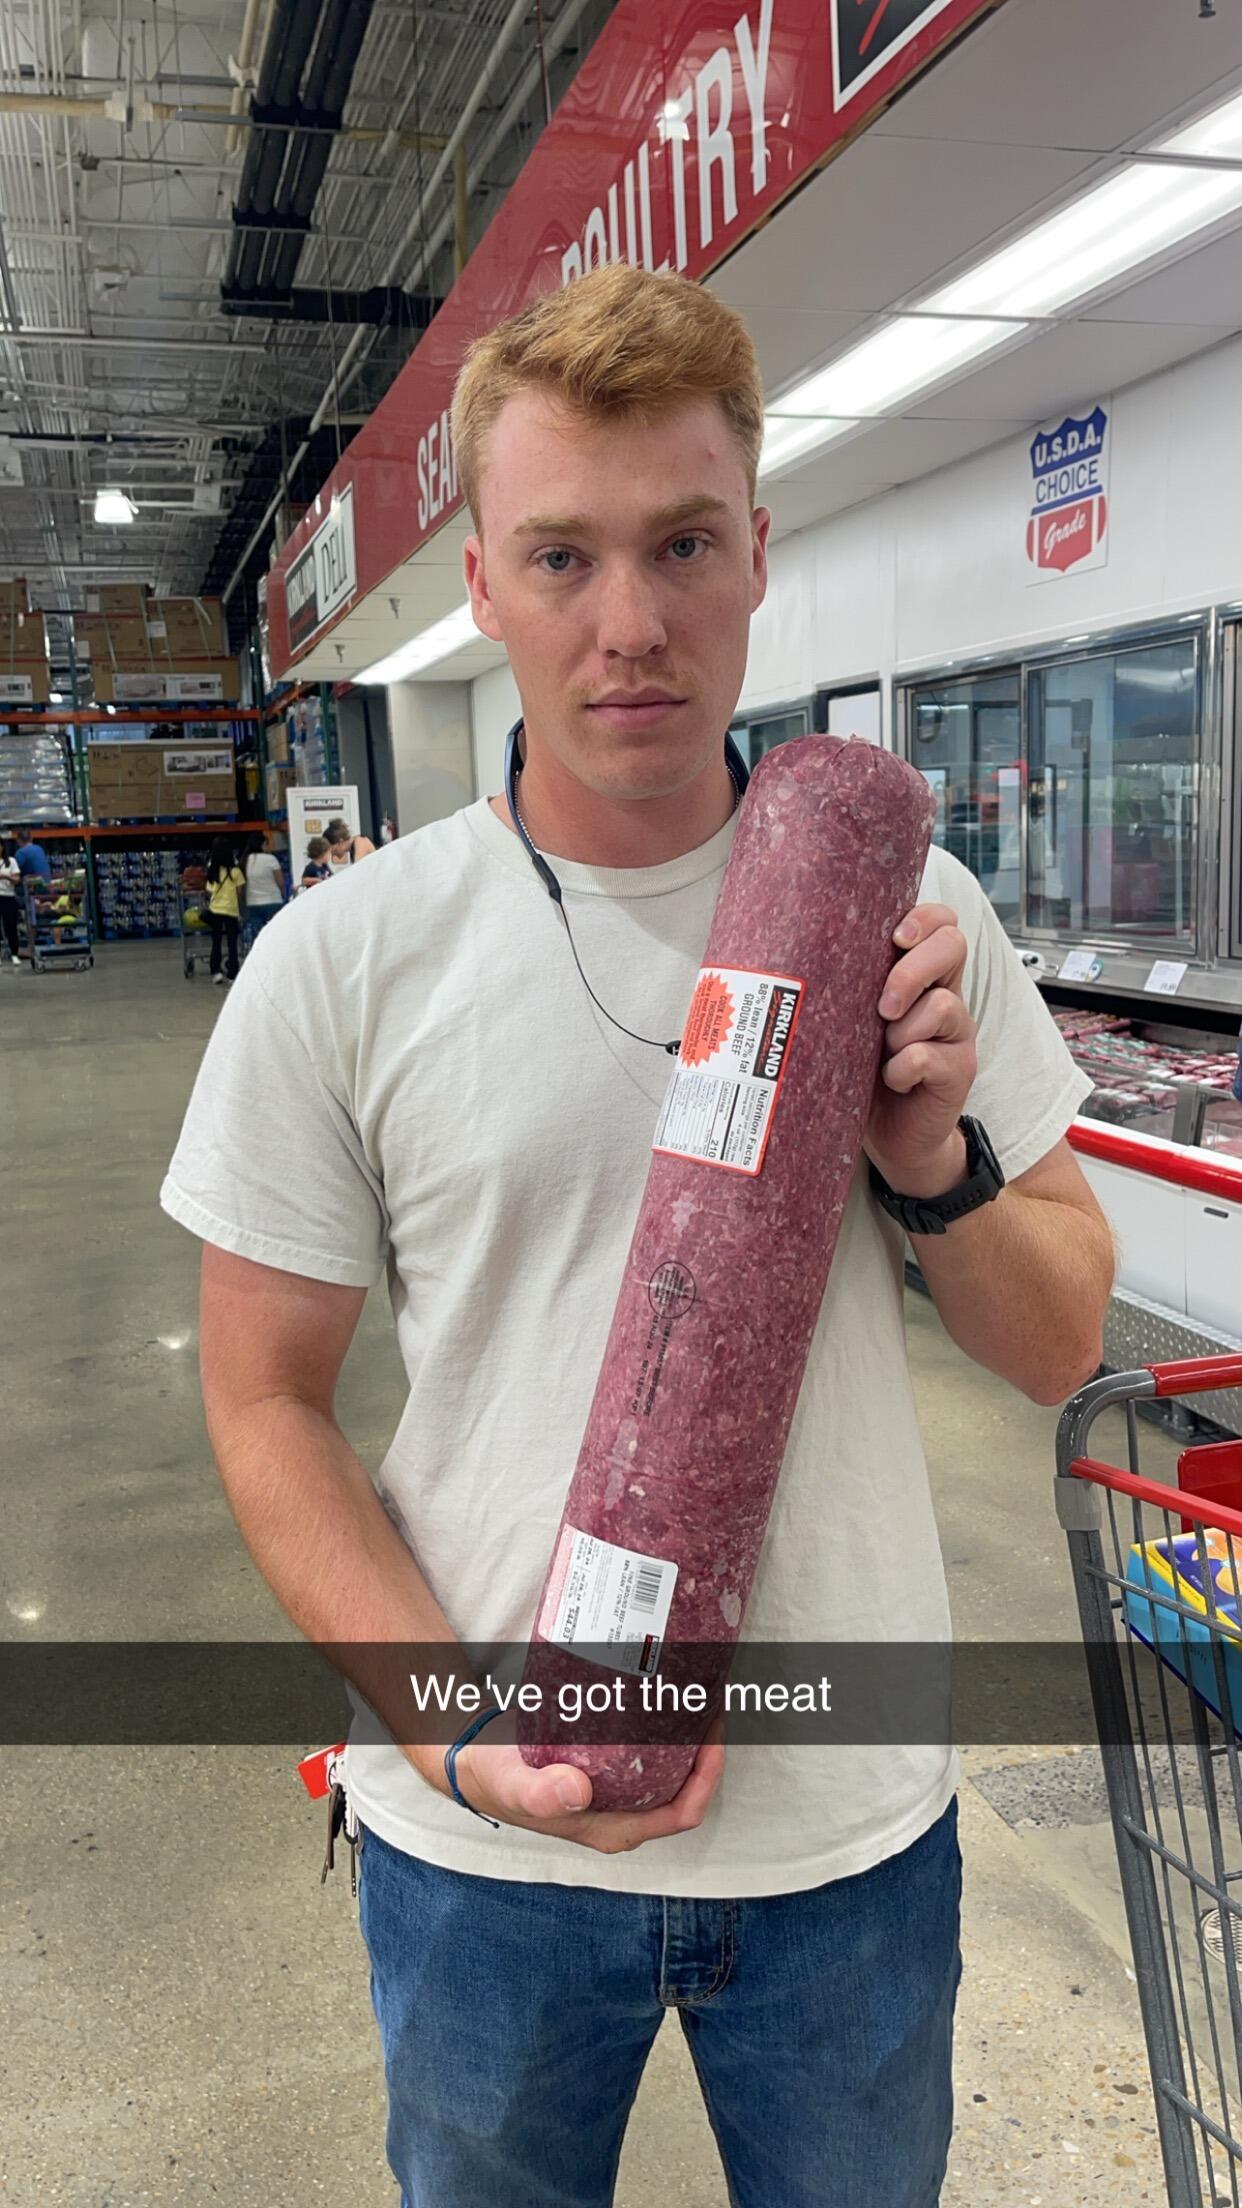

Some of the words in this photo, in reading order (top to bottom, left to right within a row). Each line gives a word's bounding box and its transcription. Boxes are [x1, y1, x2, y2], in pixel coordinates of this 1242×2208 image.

[1034, 423, 1101, 468] U.S.D.A.
[417, 409, 458, 530] SEA
[1036, 459, 1099, 503] CHOICE
[1043, 508, 1087, 560] Grade
[321, 525, 348, 604] DELI
[716, 994, 727, 1014] COOK
[755, 982, 768, 1005] 88%
[700, 999, 716, 1041] THOROUGHLY
[713, 1014, 722, 1026] ALL
[736, 992, 754, 1031] GROUND
[749, 1006, 762, 1028] lean
[707, 1027, 719, 1050] MEATS
[730, 1032, 744, 1056] BEEF
[742, 1036, 755, 1058] 12%
[763, 991, 796, 1078] KIRKLAND
[738, 1059, 749, 1073] fat
[718, 1081, 731, 1112] Calories
[749, 1088, 768, 1135] Nutrition
[707, 1139, 718, 1158] 210
[742, 1137, 756, 1166] Facts
